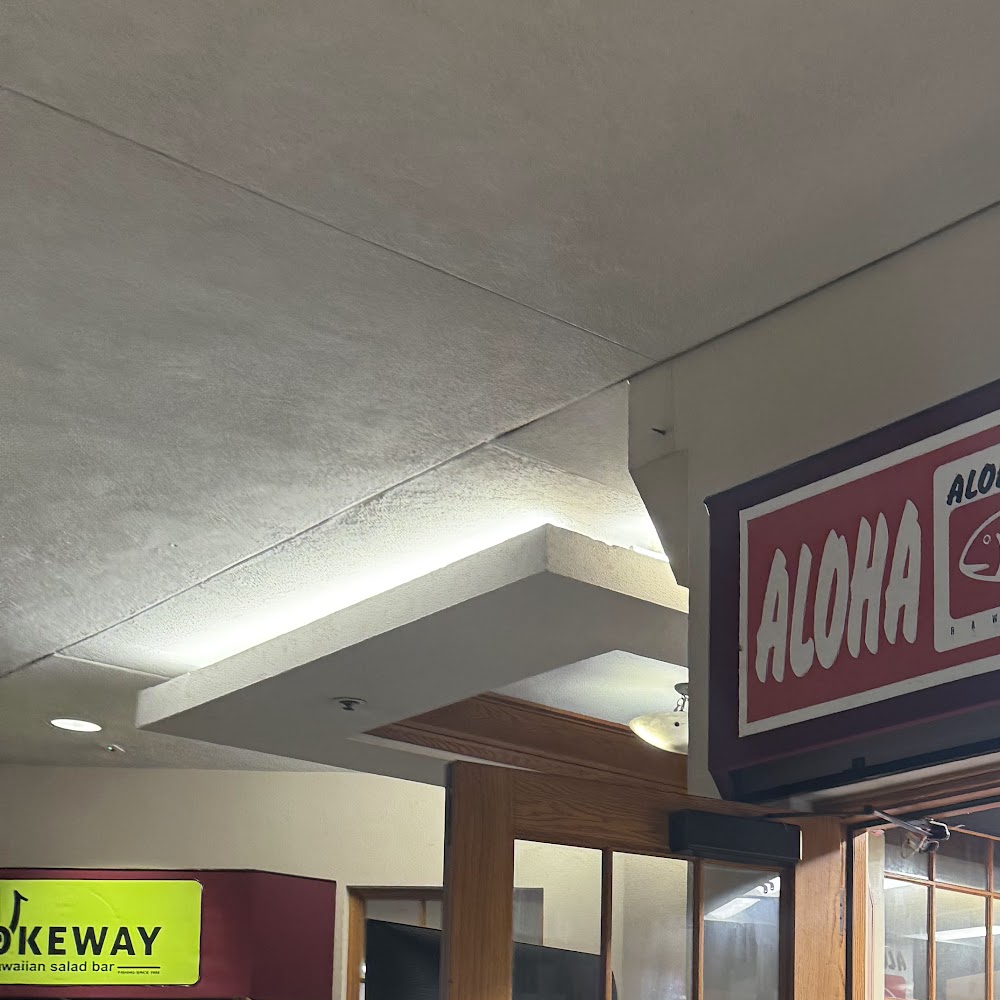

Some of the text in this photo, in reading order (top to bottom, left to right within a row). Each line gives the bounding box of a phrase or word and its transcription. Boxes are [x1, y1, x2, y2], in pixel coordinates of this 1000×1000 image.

[756, 500, 921, 682] ALOHA
[0, 960, 115, 972] waiian salad bar
